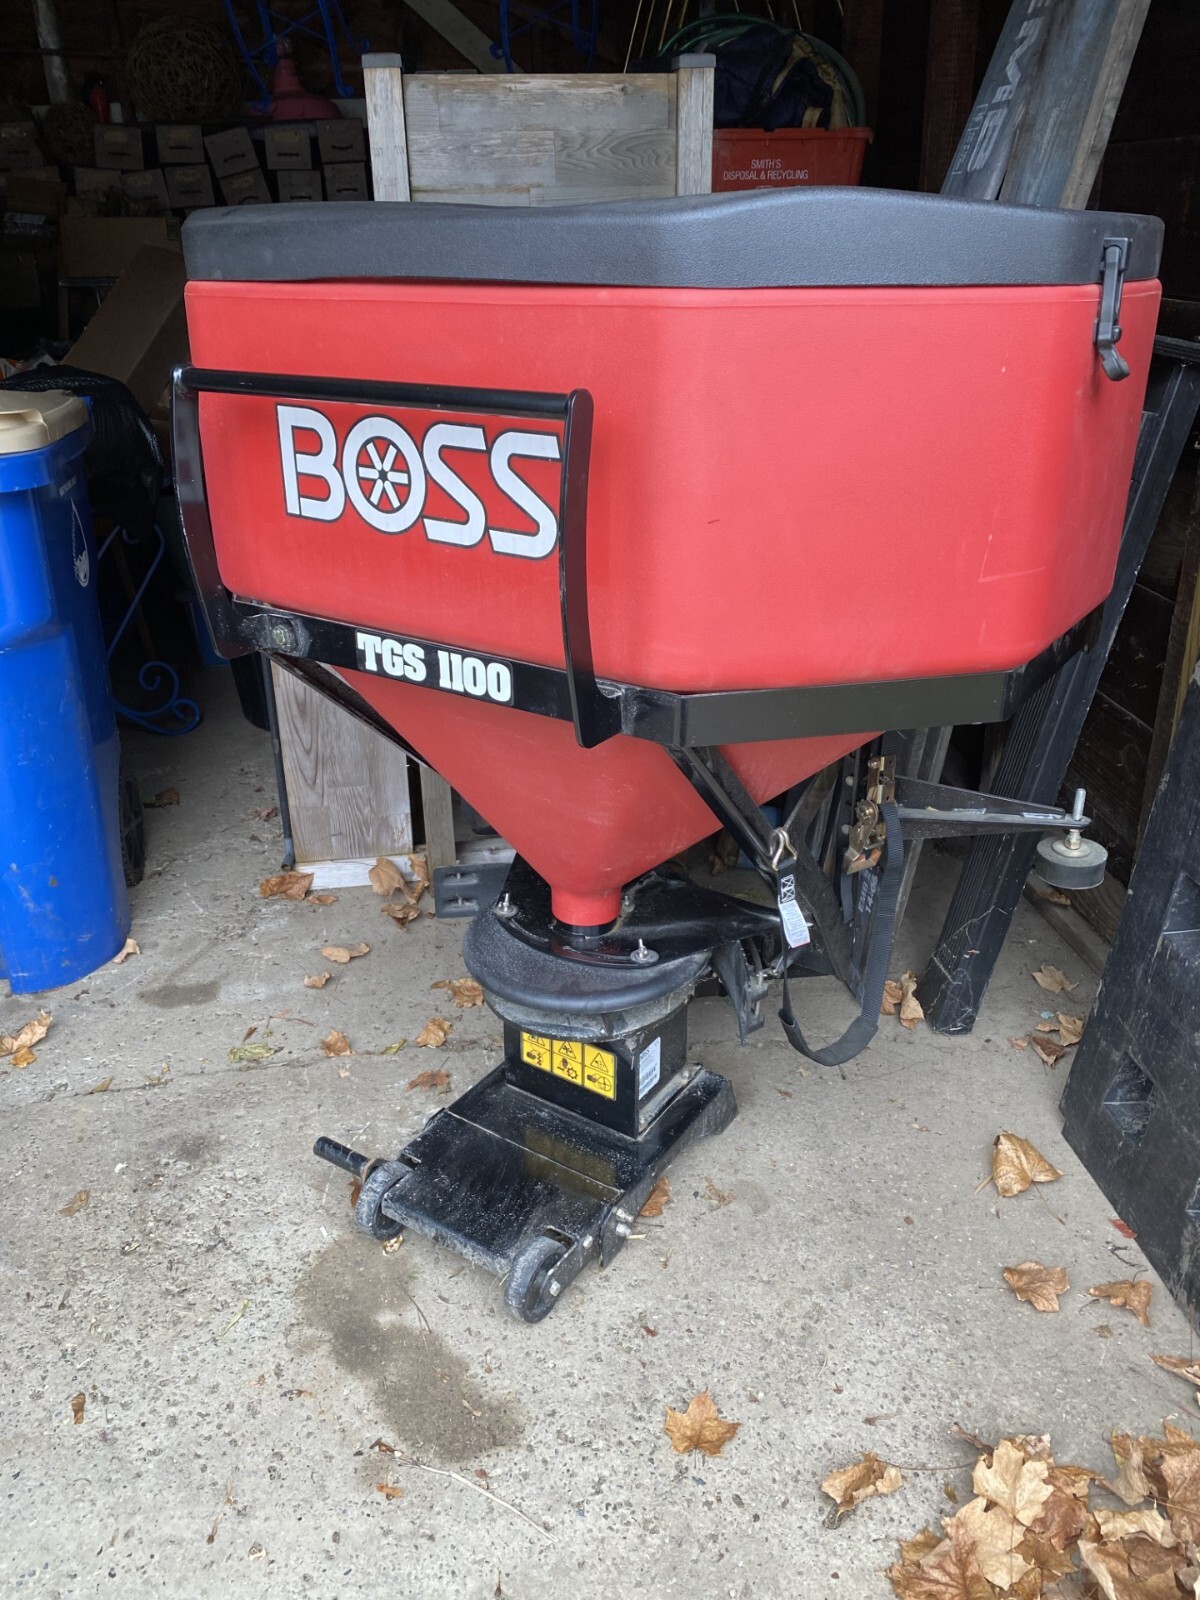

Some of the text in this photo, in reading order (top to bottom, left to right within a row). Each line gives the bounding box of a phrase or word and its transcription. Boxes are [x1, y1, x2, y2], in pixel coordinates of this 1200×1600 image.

[723, 169, 808, 180] DISPOSAL & RECYCLING
[751, 159, 781, 169] SMITH'S
[276, 404, 561, 560] BOSS
[356, 631, 511, 702] TGS 1100
